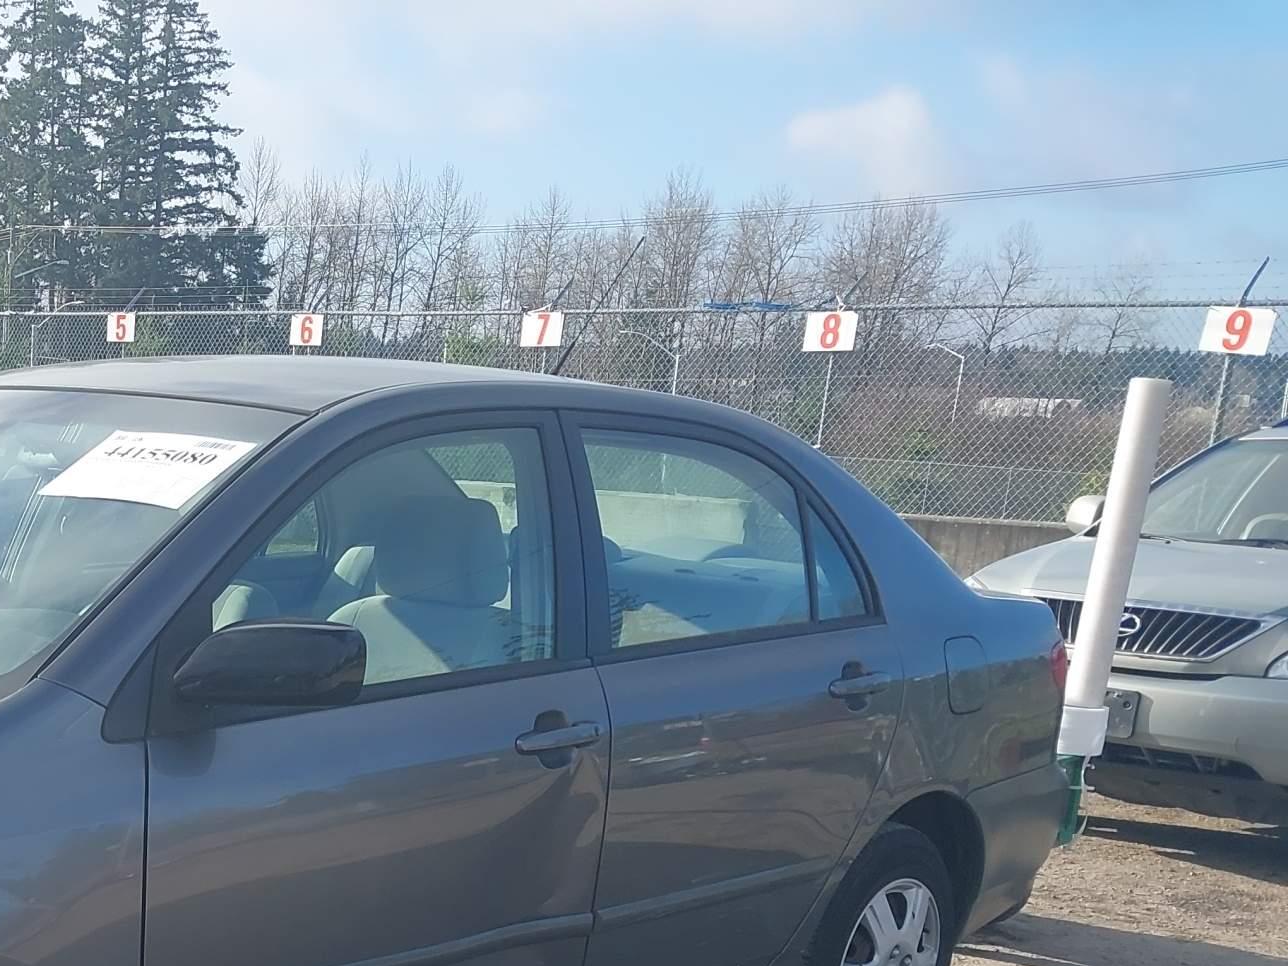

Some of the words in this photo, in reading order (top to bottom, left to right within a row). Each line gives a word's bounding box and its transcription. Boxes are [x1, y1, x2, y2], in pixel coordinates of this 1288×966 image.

[115, 314, 127, 341] 5
[300, 316, 314, 344] 6
[537, 313, 551, 345] 7
[820, 313, 842, 349] 8
[1222, 309, 1253, 352] 9
